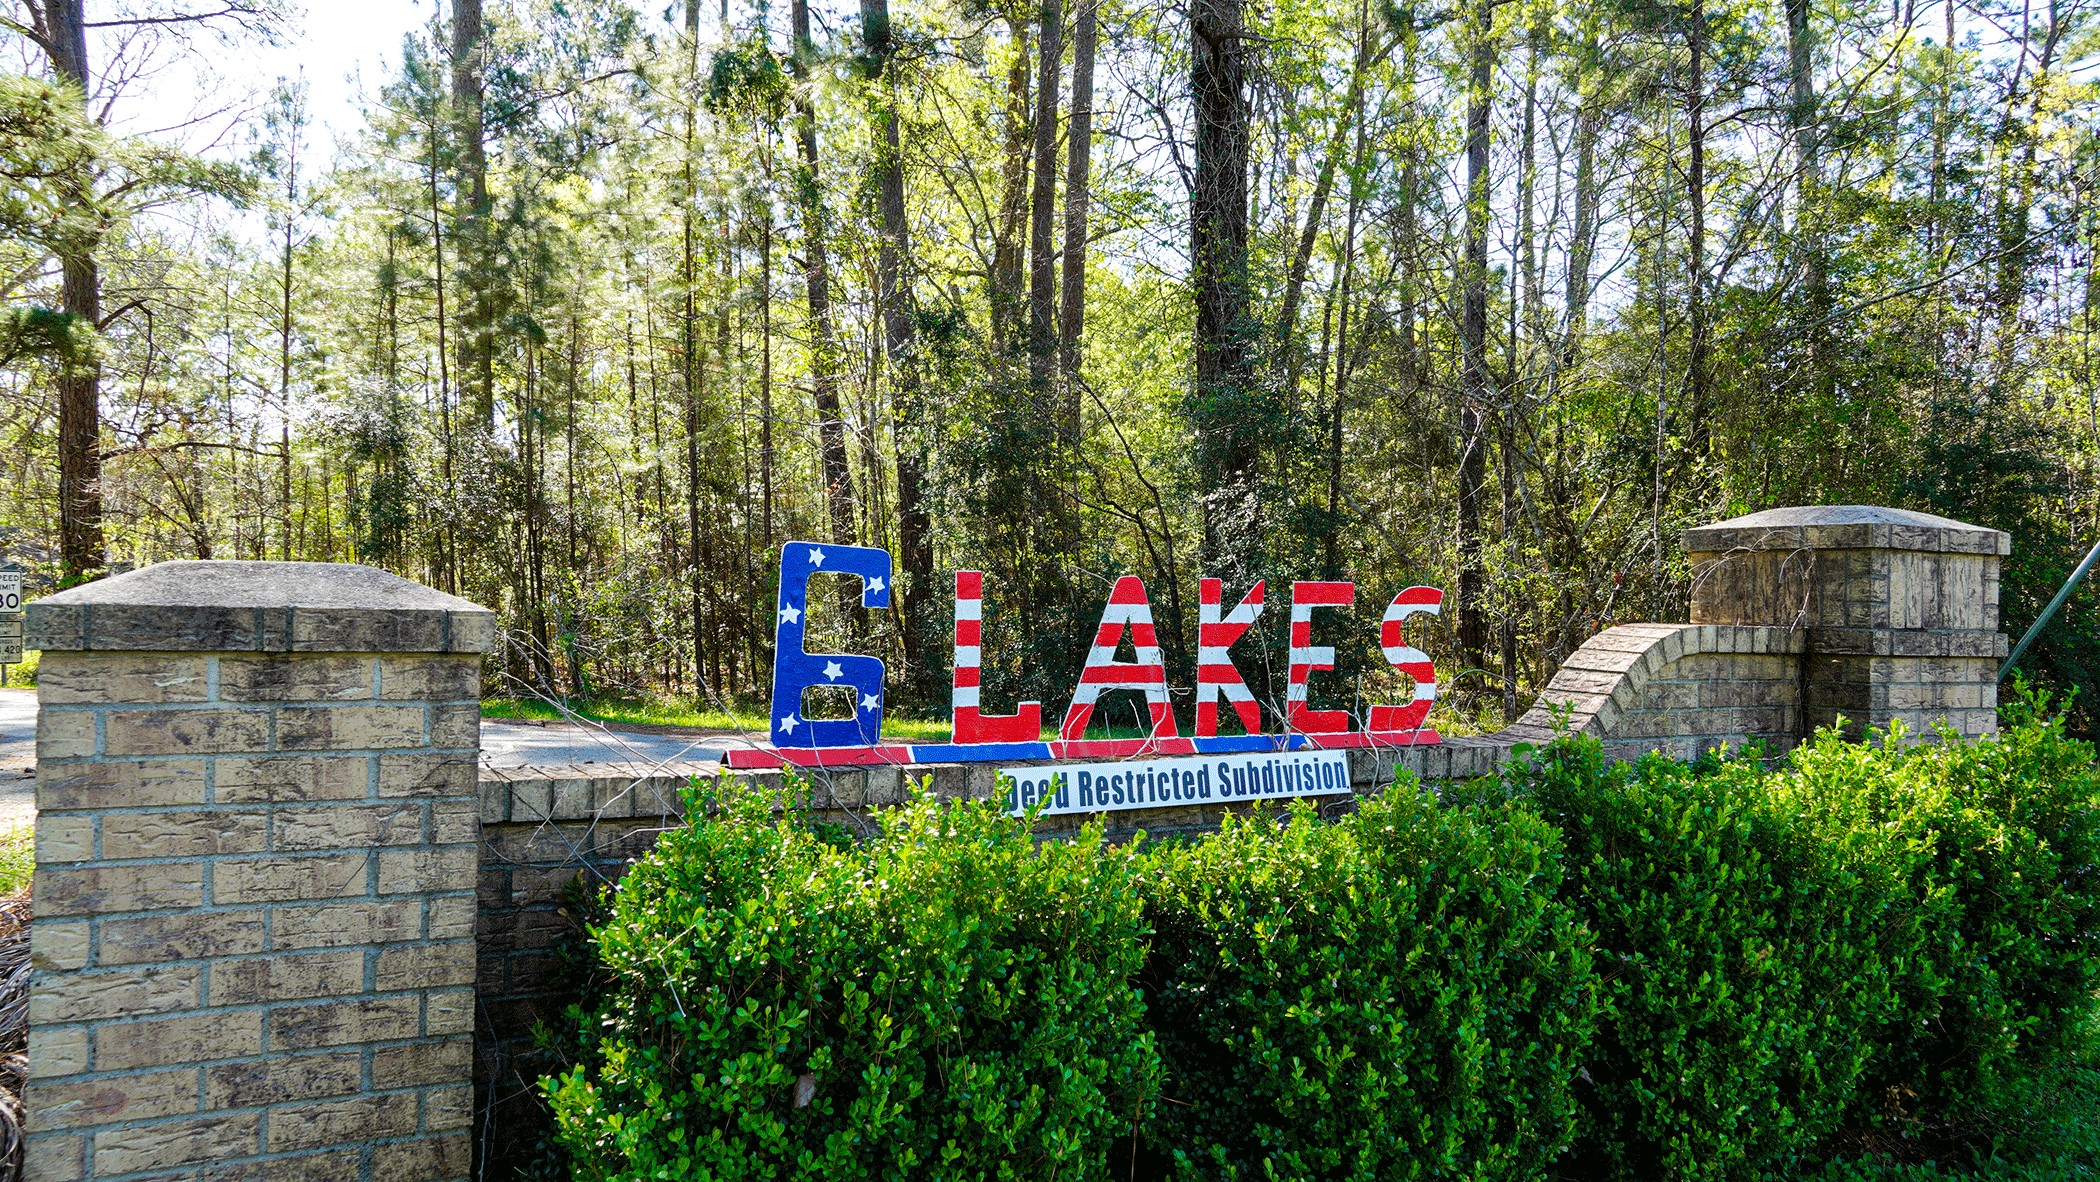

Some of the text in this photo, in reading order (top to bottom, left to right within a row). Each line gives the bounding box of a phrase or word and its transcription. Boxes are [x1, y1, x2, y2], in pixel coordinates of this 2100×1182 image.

[770, 541, 1444, 749] 6 LAKES
[1006, 757, 1347, 811] Deed Restricted Subdivision
